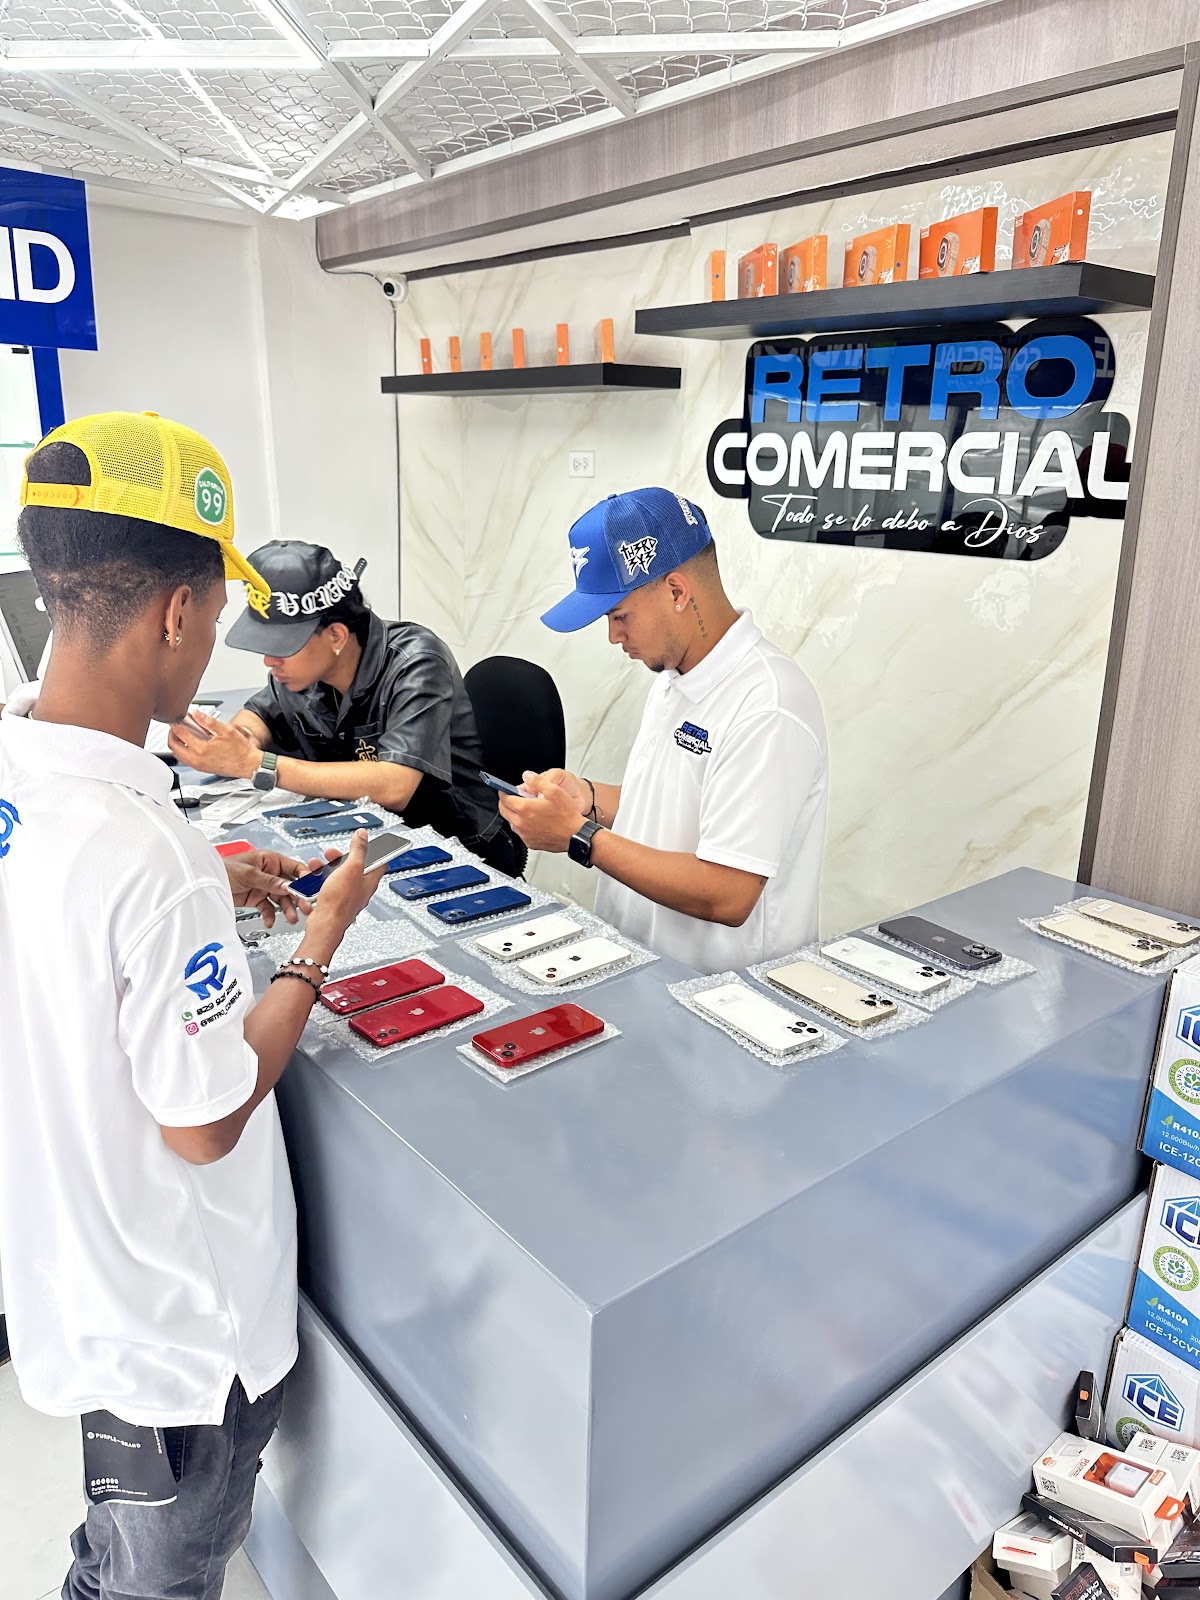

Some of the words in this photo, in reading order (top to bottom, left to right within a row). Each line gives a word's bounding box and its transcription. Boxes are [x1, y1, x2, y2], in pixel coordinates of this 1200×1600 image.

[751, 335, 1095, 423] RETRO
[713, 430, 1131, 500] COMERCIAL
[201, 488, 223, 516] 99
[761, 493, 818, 532] Todo
[821, 514, 847, 531] se
[852, 504, 876, 532] lo
[881, 509, 932, 531] debo
[941, 518, 963, 532] a
[962, 498, 1047, 547] Dios
[682, 722, 708, 740] RETRO
[1172, 1121, 1200, 1140] R410
[1165, 1205, 1200, 1245] IC
[1157, 1303, 1189, 1327] R410A
[1126, 1381, 1180, 1426] ICE
